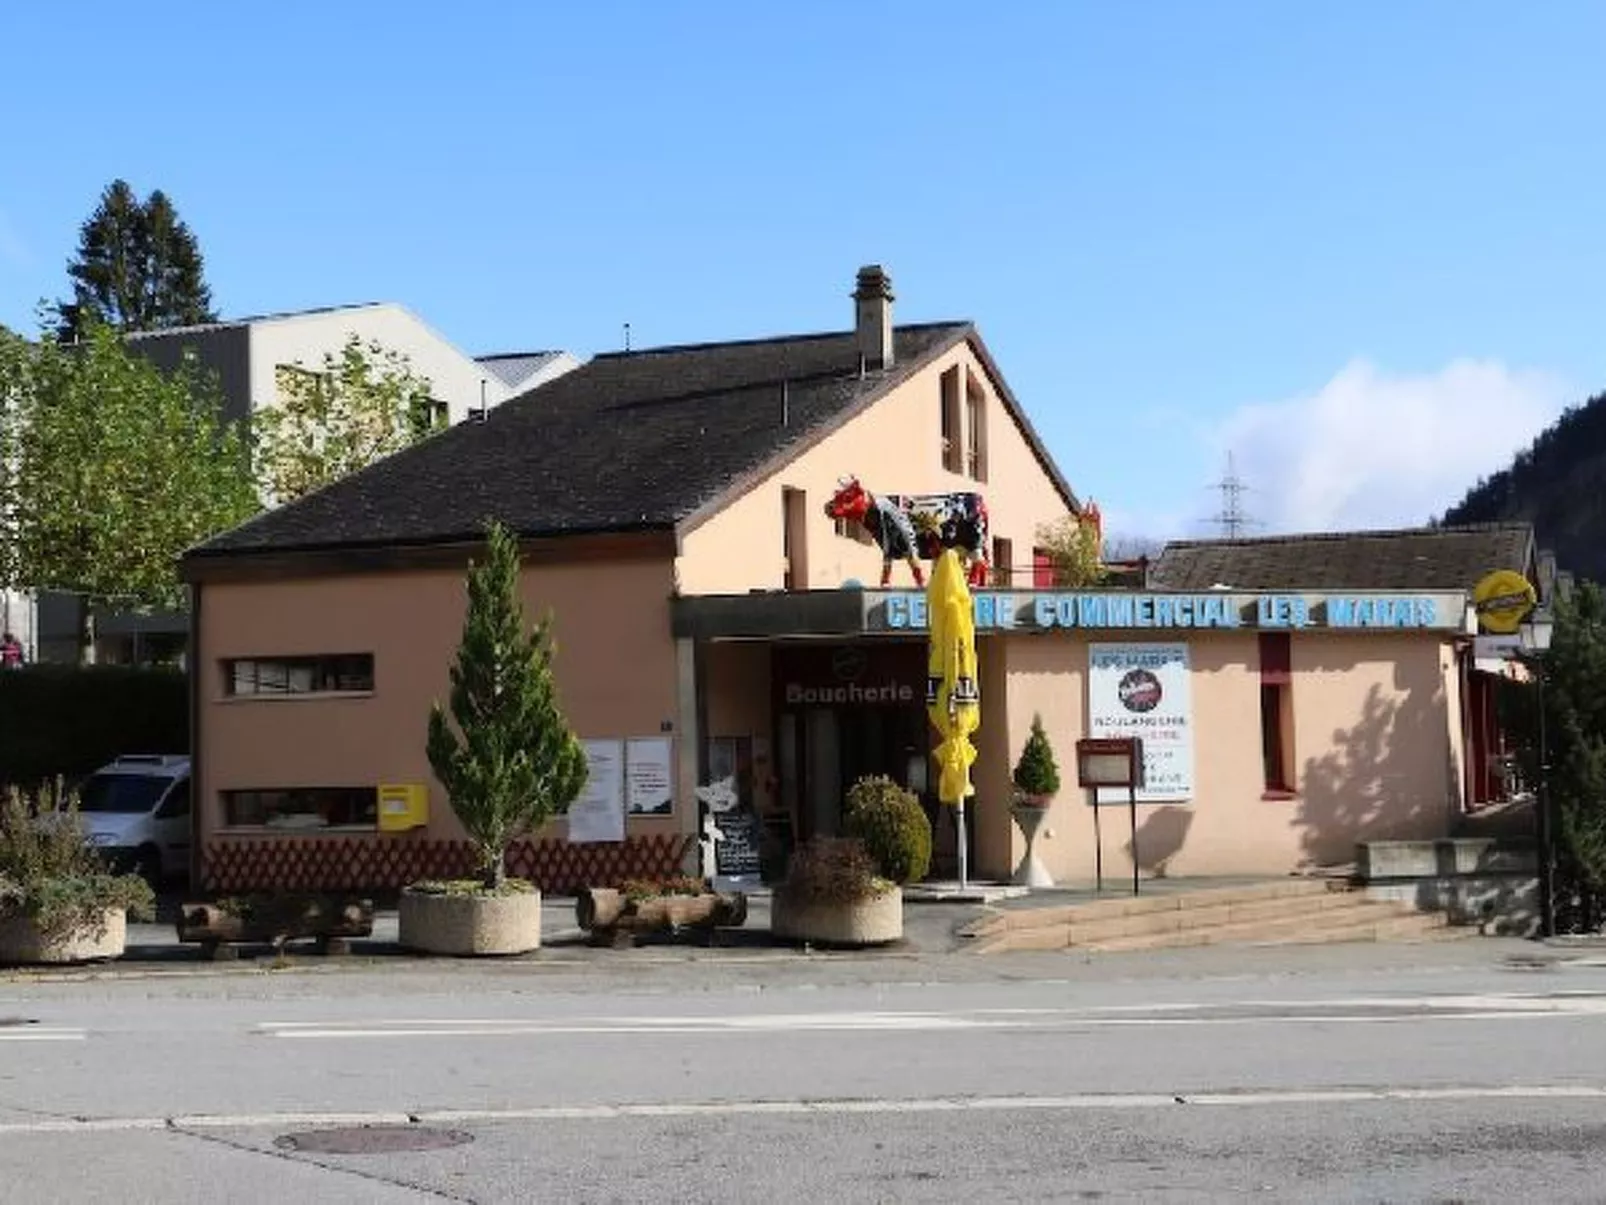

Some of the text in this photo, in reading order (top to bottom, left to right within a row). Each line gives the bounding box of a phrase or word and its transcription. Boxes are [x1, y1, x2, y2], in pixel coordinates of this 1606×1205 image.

[887, 594, 1436, 629] CERE COMMERCIAL LES MARAIS
[786, 679, 914, 703] Boucherie
